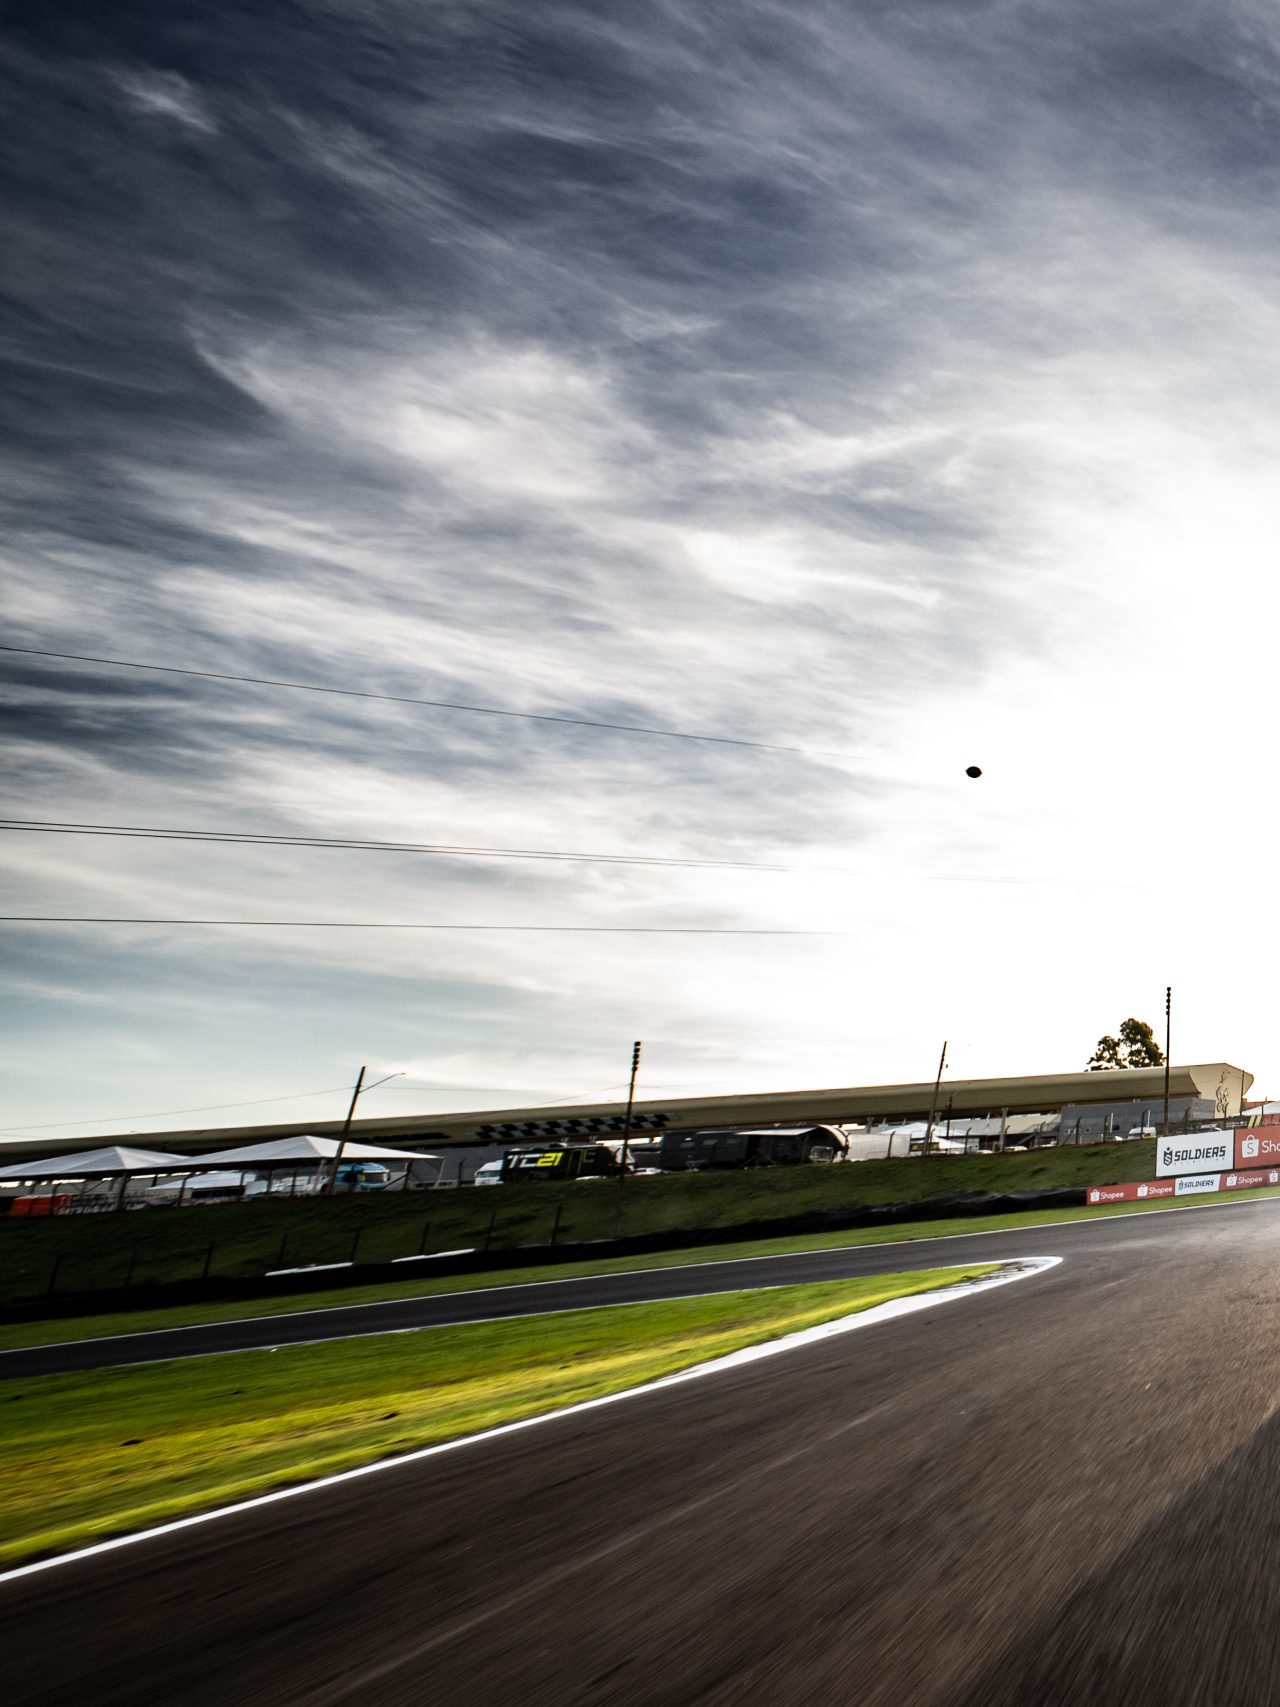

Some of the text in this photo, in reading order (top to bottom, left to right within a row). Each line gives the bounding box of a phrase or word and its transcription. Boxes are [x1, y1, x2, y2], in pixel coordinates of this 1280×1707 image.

[1174, 1146, 1226, 1161] SOLDIERS
[507, 1152, 563, 1168] TC21
[1184, 1180, 1214, 1188] SOLDIERS
[1238, 1176, 1263, 1185] Shopee
[1149, 1186, 1172, 1195] Shopee
[1101, 1191, 1124, 1200] Shopee
